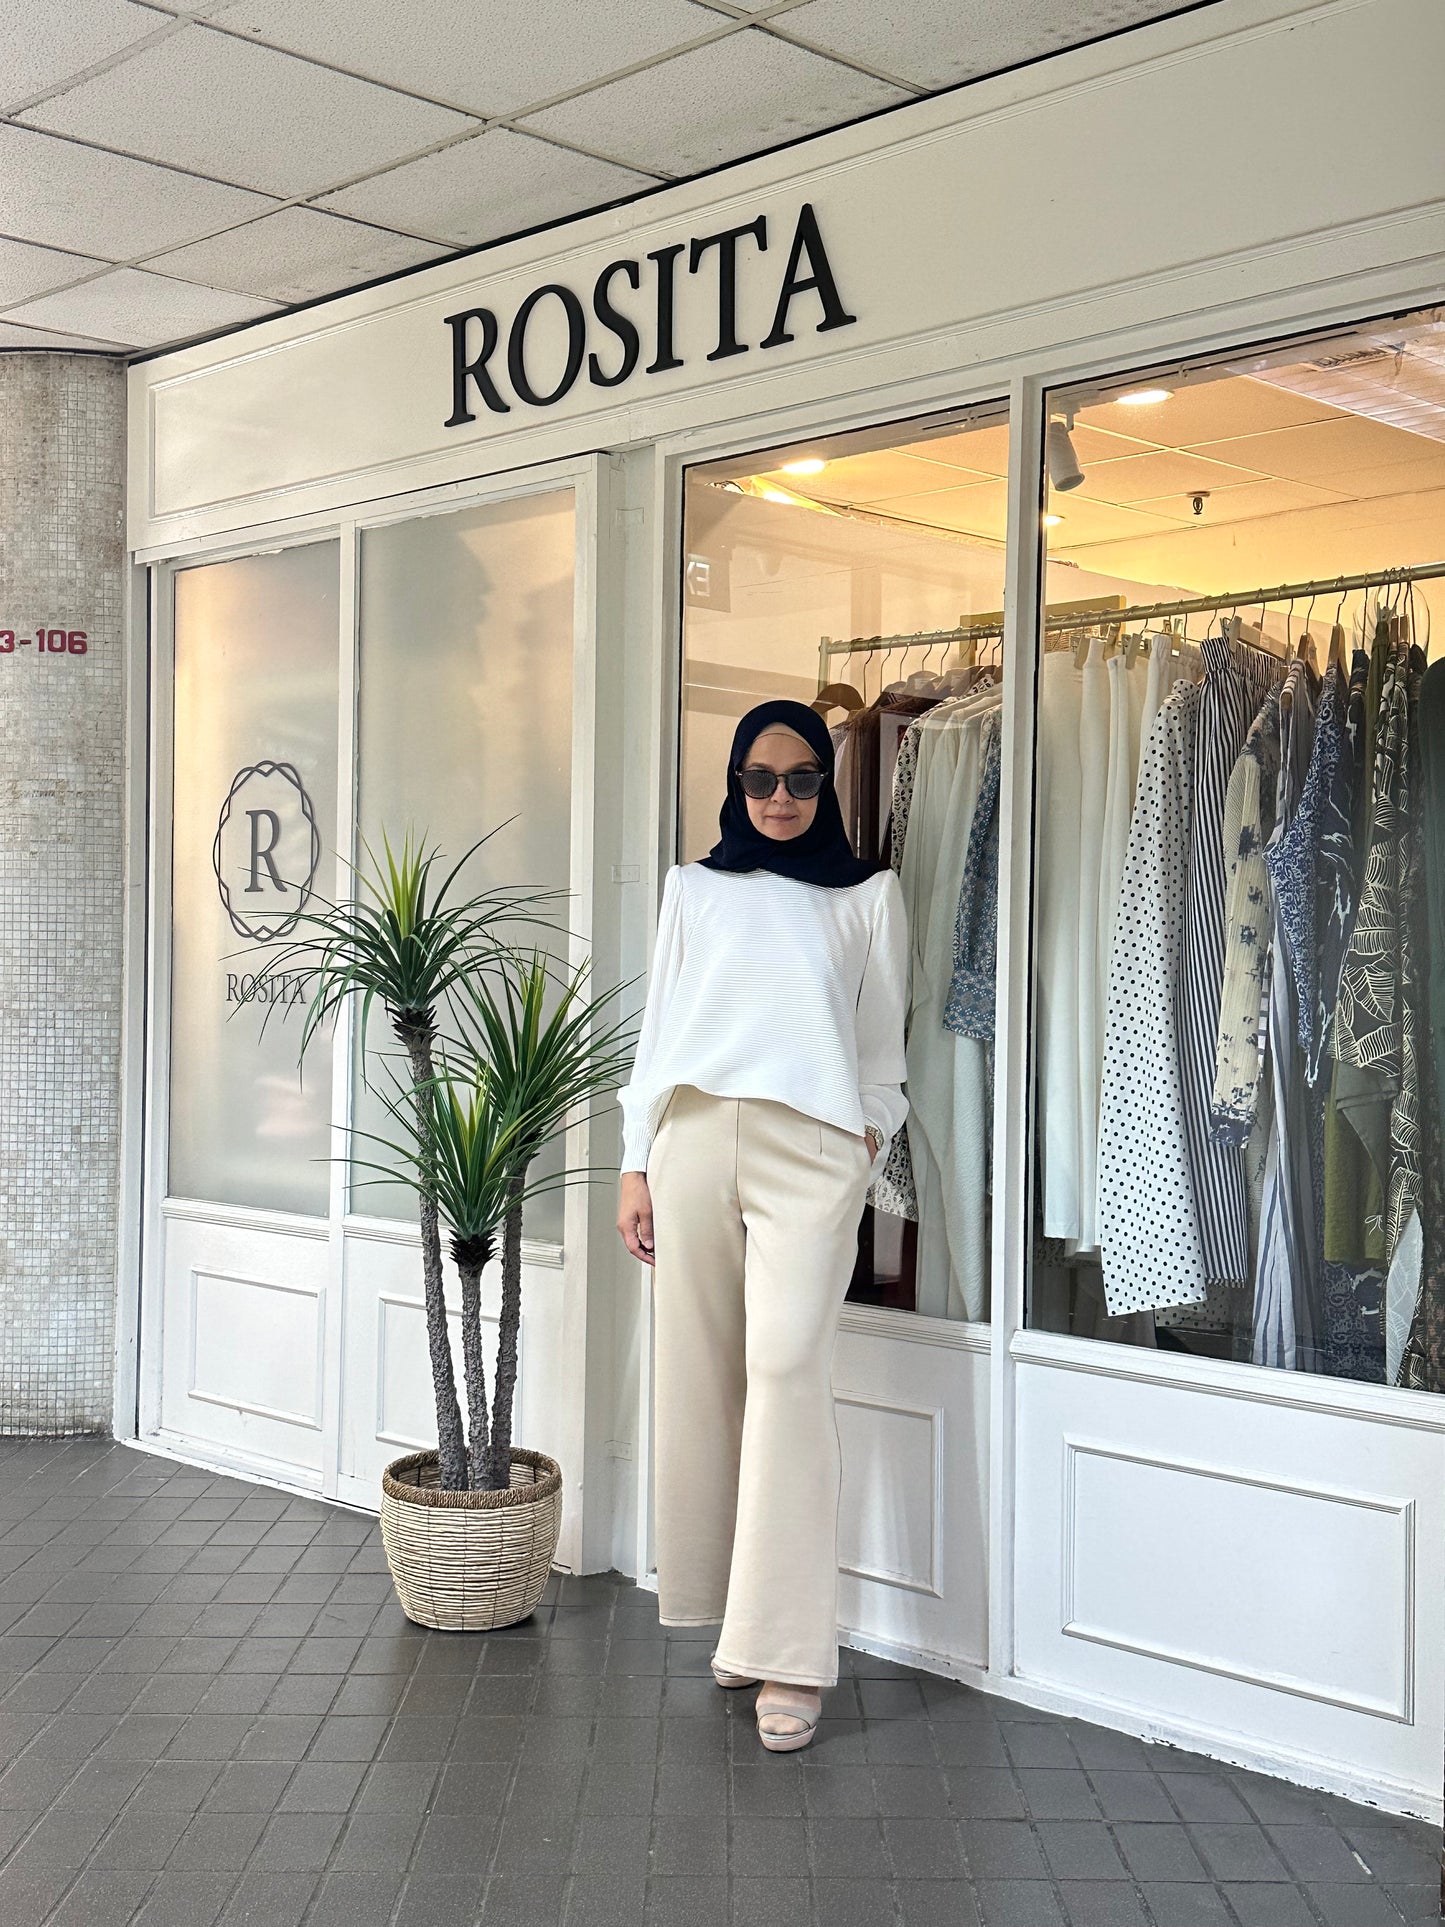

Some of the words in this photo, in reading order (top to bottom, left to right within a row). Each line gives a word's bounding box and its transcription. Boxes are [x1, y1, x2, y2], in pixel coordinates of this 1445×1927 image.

[444, 203, 857, 428] ROSITA
[244, 809, 287, 893] R
[226, 973, 307, 1004] ROSITA
